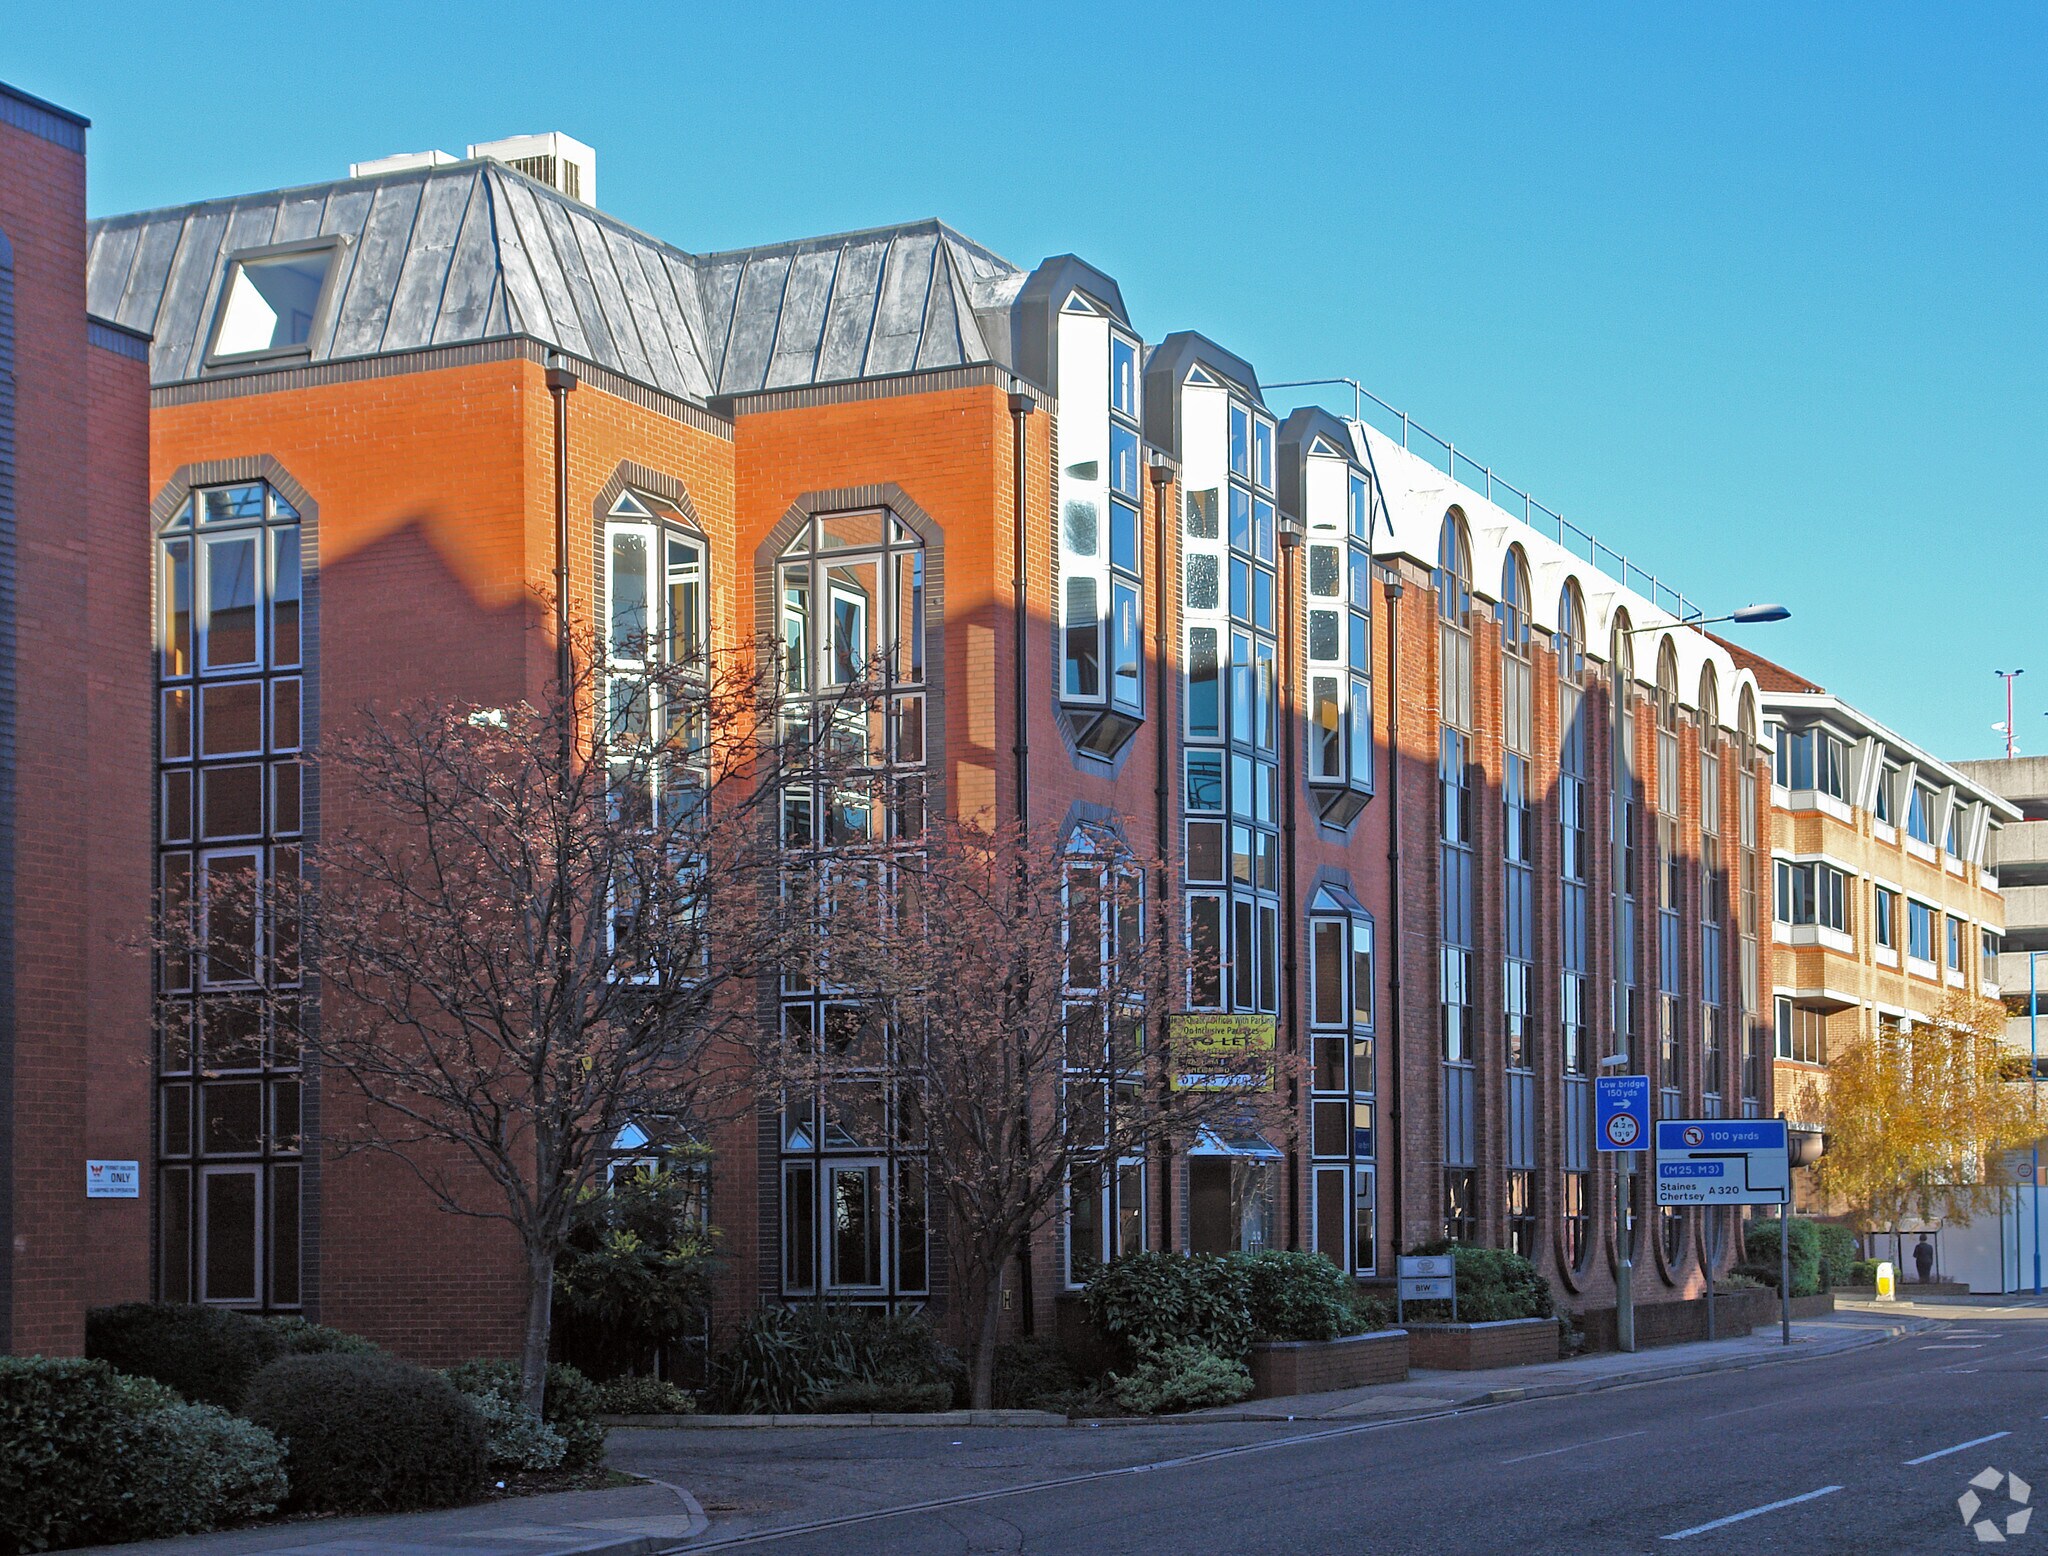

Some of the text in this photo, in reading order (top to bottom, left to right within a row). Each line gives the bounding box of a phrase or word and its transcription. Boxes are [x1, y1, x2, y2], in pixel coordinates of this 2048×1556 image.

[1235, 1016, 1250, 1025] With
[1600, 1080, 1645, 1090] Low bridge
[1607, 1088, 1638, 1098] 150 yds
[1711, 1131, 1759, 1142] 100 yards
[1698, 1165, 1720, 1174] M3)
[111, 1172, 131, 1183] ONLY
[1660, 1182, 1697, 1191] Staines
[1660, 1192, 1705, 1201] Chertsey
